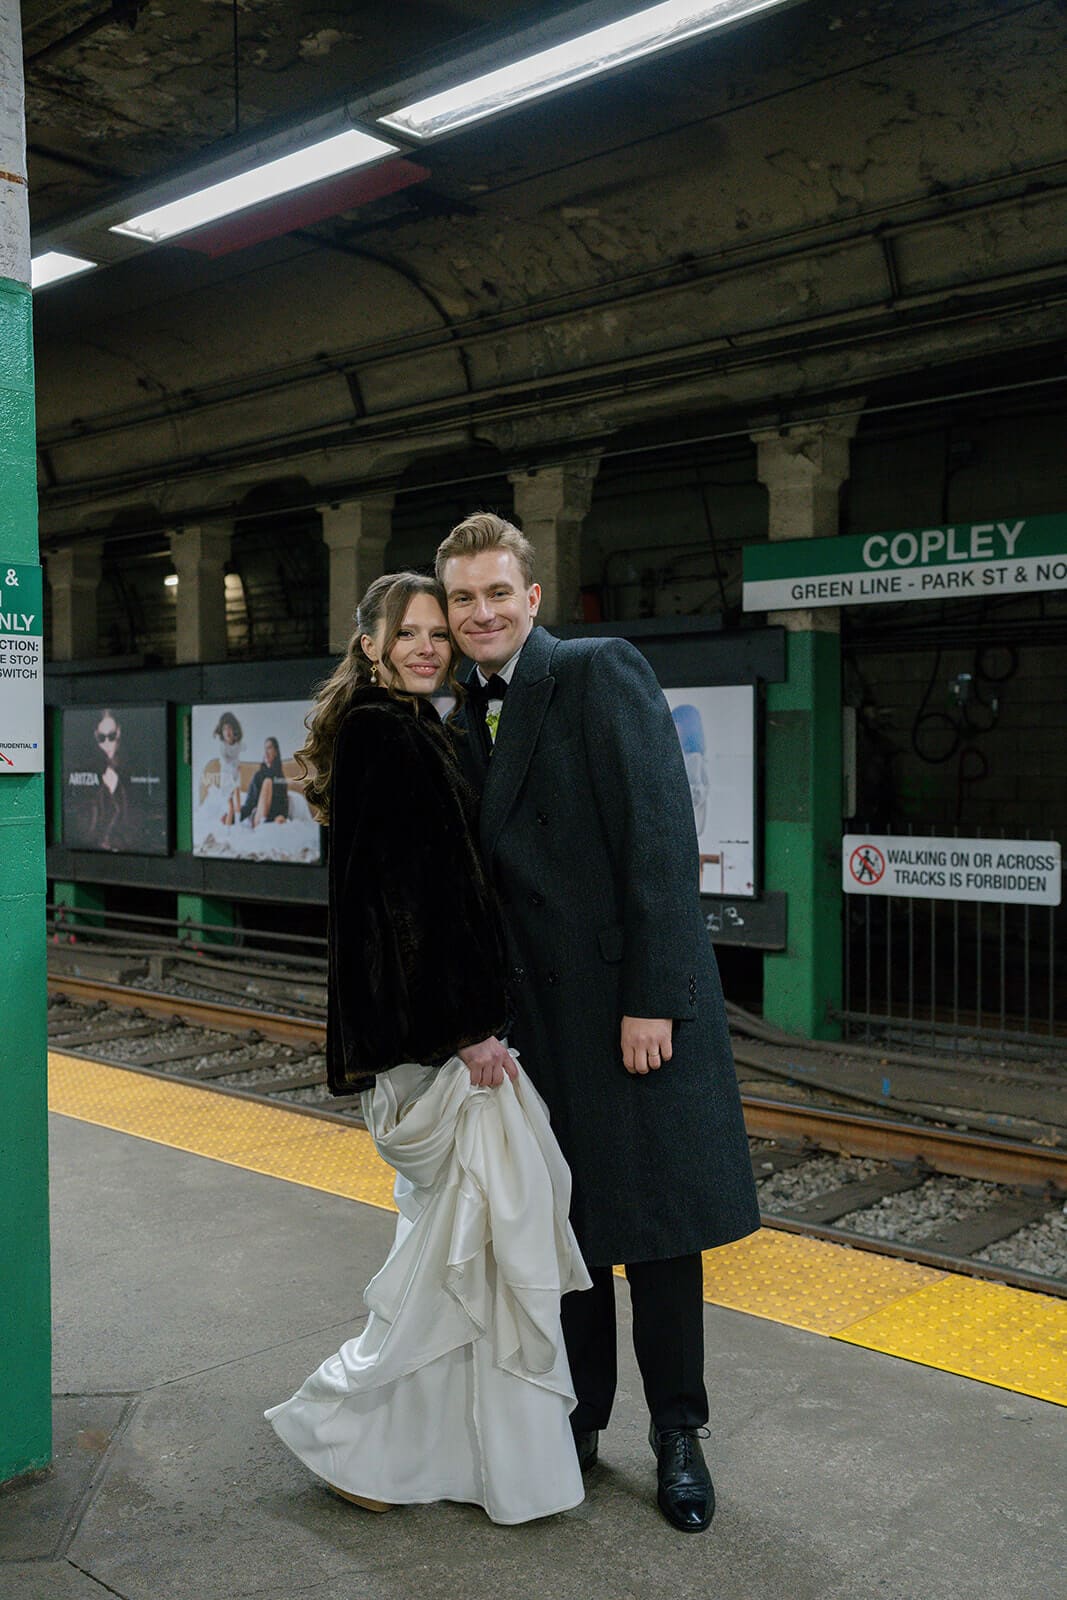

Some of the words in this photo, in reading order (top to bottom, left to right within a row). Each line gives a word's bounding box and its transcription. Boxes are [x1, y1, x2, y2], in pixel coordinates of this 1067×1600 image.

[863, 521, 1026, 568] COPLEY
[5, 568, 19, 586] &
[791, 580, 853, 600] GREEN
[859, 577, 901, 595] LINE
[921, 570, 975, 590] PARK
[982, 567, 1008, 585] ST
[1014, 566, 1028, 583] &
[1037, 562, 1067, 581] NO
[0, 612, 35, 631] NLY
[9, 655, 38, 665] STOP
[887, 849, 947, 867] WALKING
[951, 852, 969, 868] ON
[973, 853, 992, 869] OR
[996, 854, 1055, 872] ACROSS
[894, 869, 946, 887] TRACKS
[950, 872, 962, 888] IS
[966, 874, 1047, 892] FORBIDDEN
